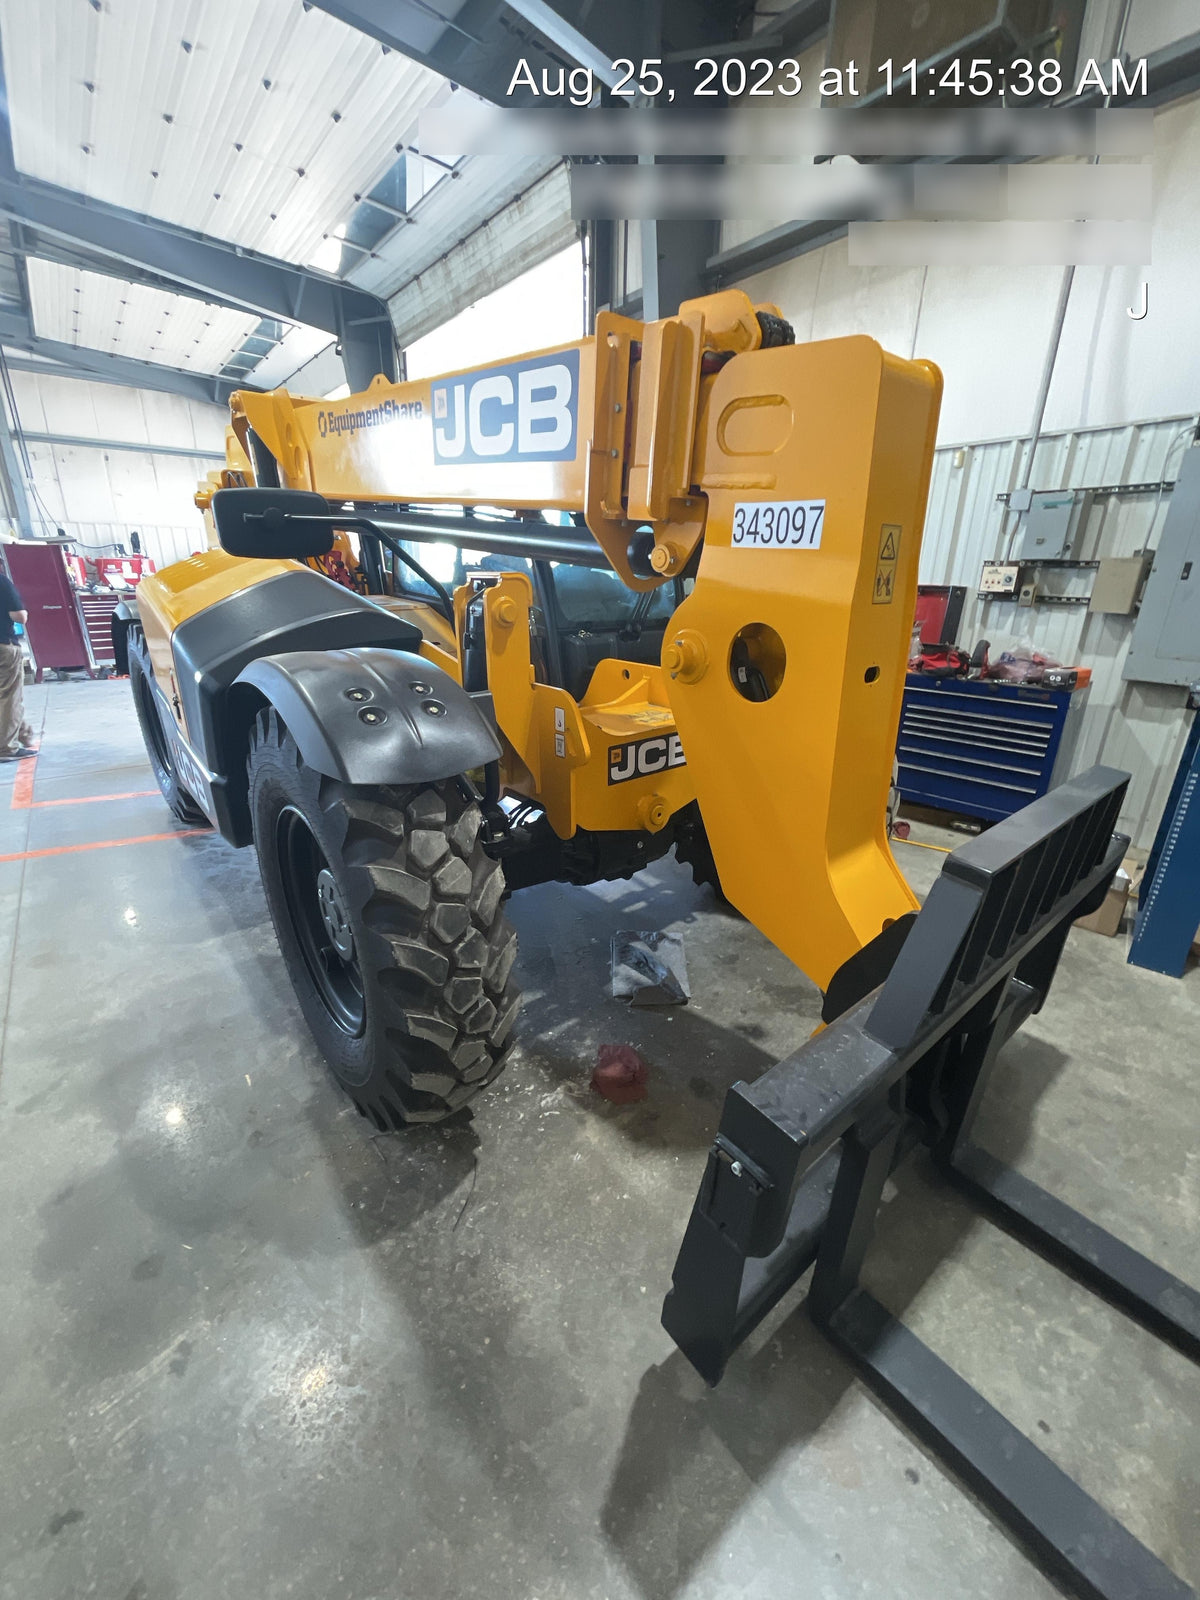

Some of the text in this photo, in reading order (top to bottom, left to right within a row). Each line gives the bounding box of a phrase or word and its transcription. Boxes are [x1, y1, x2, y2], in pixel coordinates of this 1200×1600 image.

[328, 400, 423, 437] EquipmentShare
[435, 364, 573, 458] JCB
[733, 506, 825, 545] 343097
